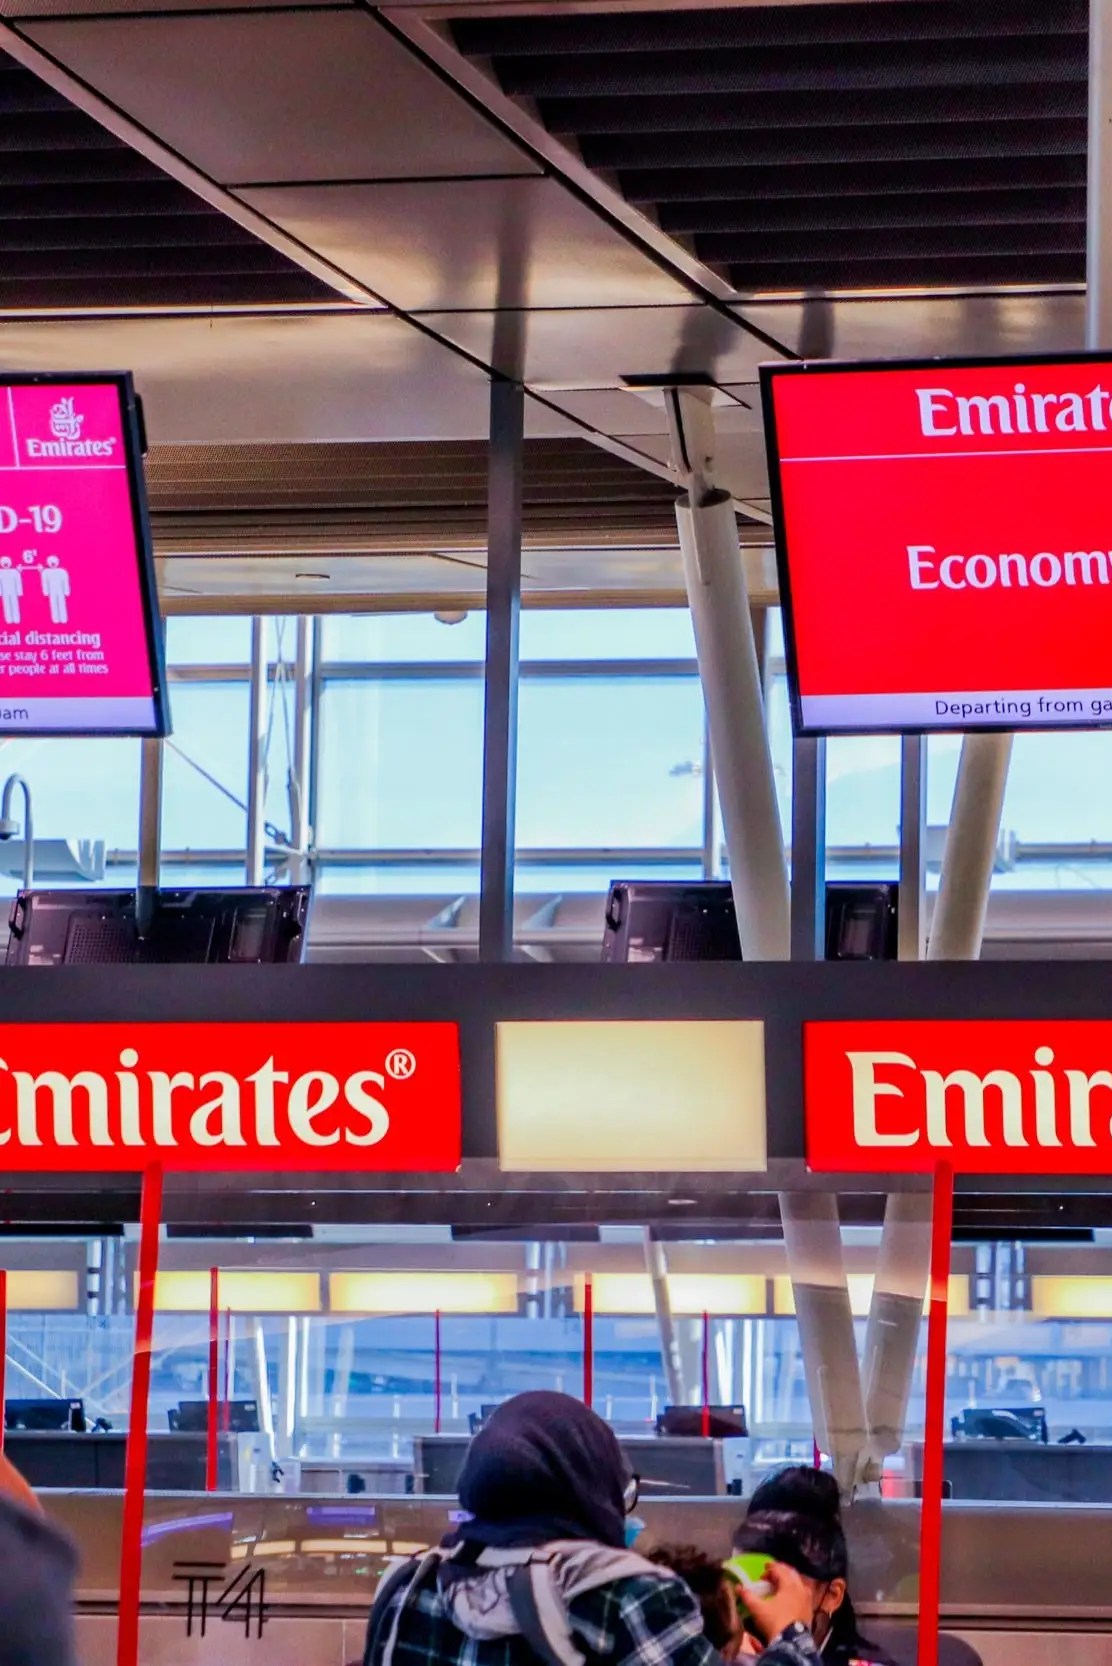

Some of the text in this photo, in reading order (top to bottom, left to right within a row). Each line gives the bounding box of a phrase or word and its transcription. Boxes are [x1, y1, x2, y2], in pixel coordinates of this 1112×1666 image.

[25, 630, 102, 650] distancing
[14, 651, 37, 663] stay
[40, 649, 49, 661] 6
[51, 649, 73, 661] feet
[76, 649, 105, 661] from
[9, 663, 46, 676] people
[49, 665, 60, 675] at
[63, 662, 77, 675] all
[79, 662, 109, 674] times
[0, 708, 29, 720] am
[934, 700, 1032, 719] Departing
[1038, 697, 1084, 714] from
